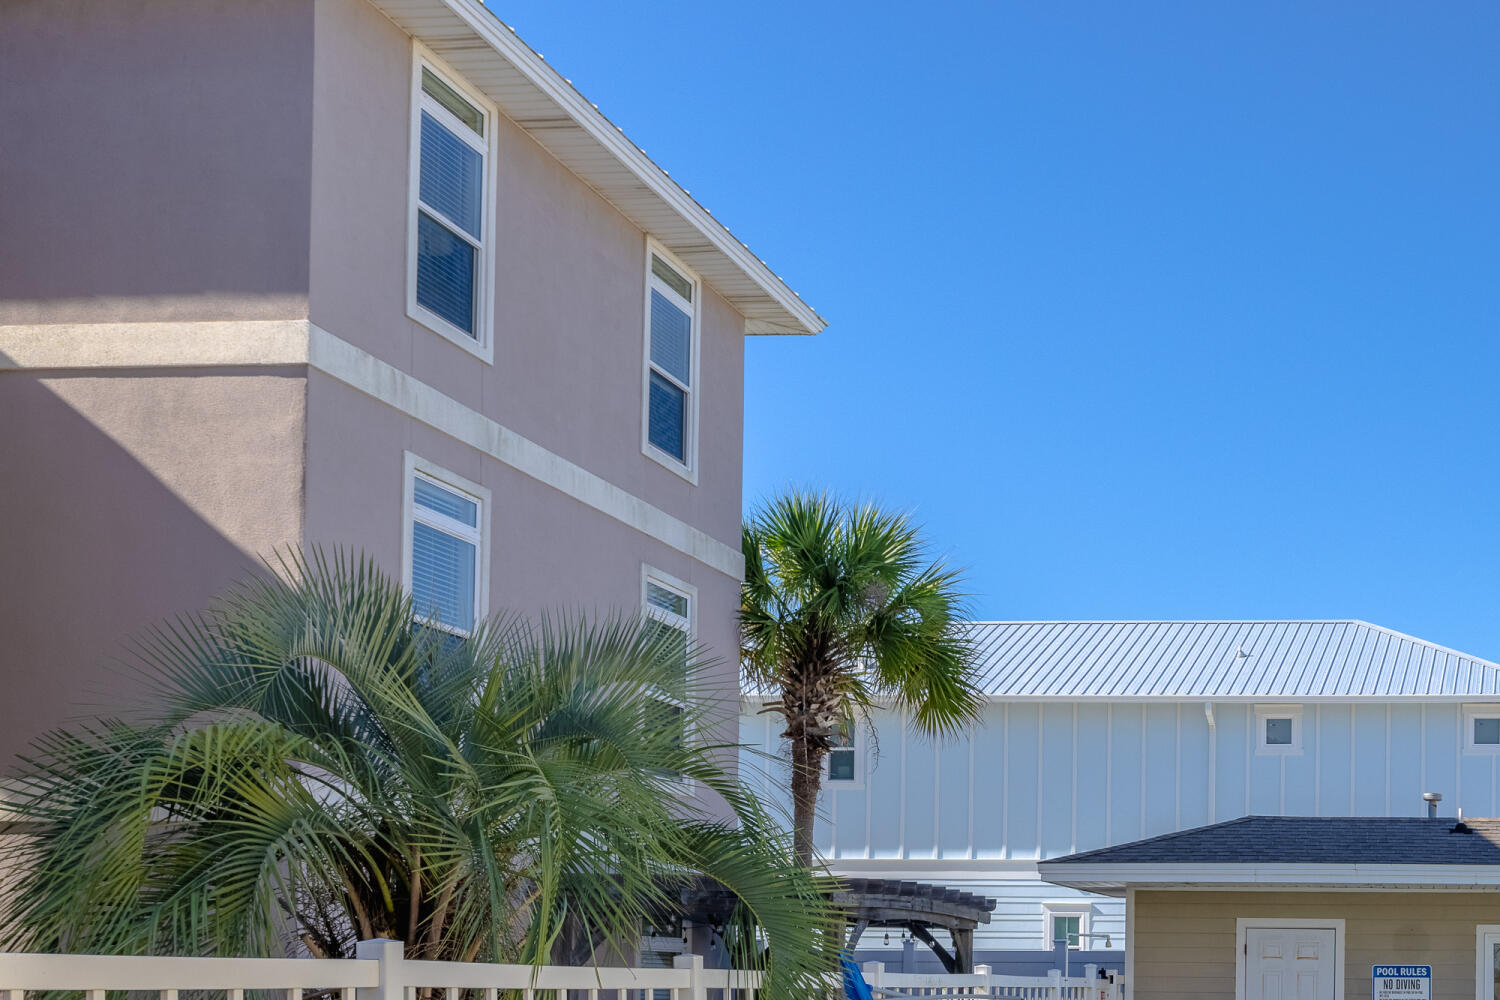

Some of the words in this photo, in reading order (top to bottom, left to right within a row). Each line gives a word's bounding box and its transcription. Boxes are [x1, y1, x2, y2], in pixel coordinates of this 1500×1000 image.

[1376, 967, 1399, 976] POOL
[1400, 967, 1428, 976] RULES
[1383, 979, 1394, 990] NO
[1396, 979, 1421, 990] DIVING
